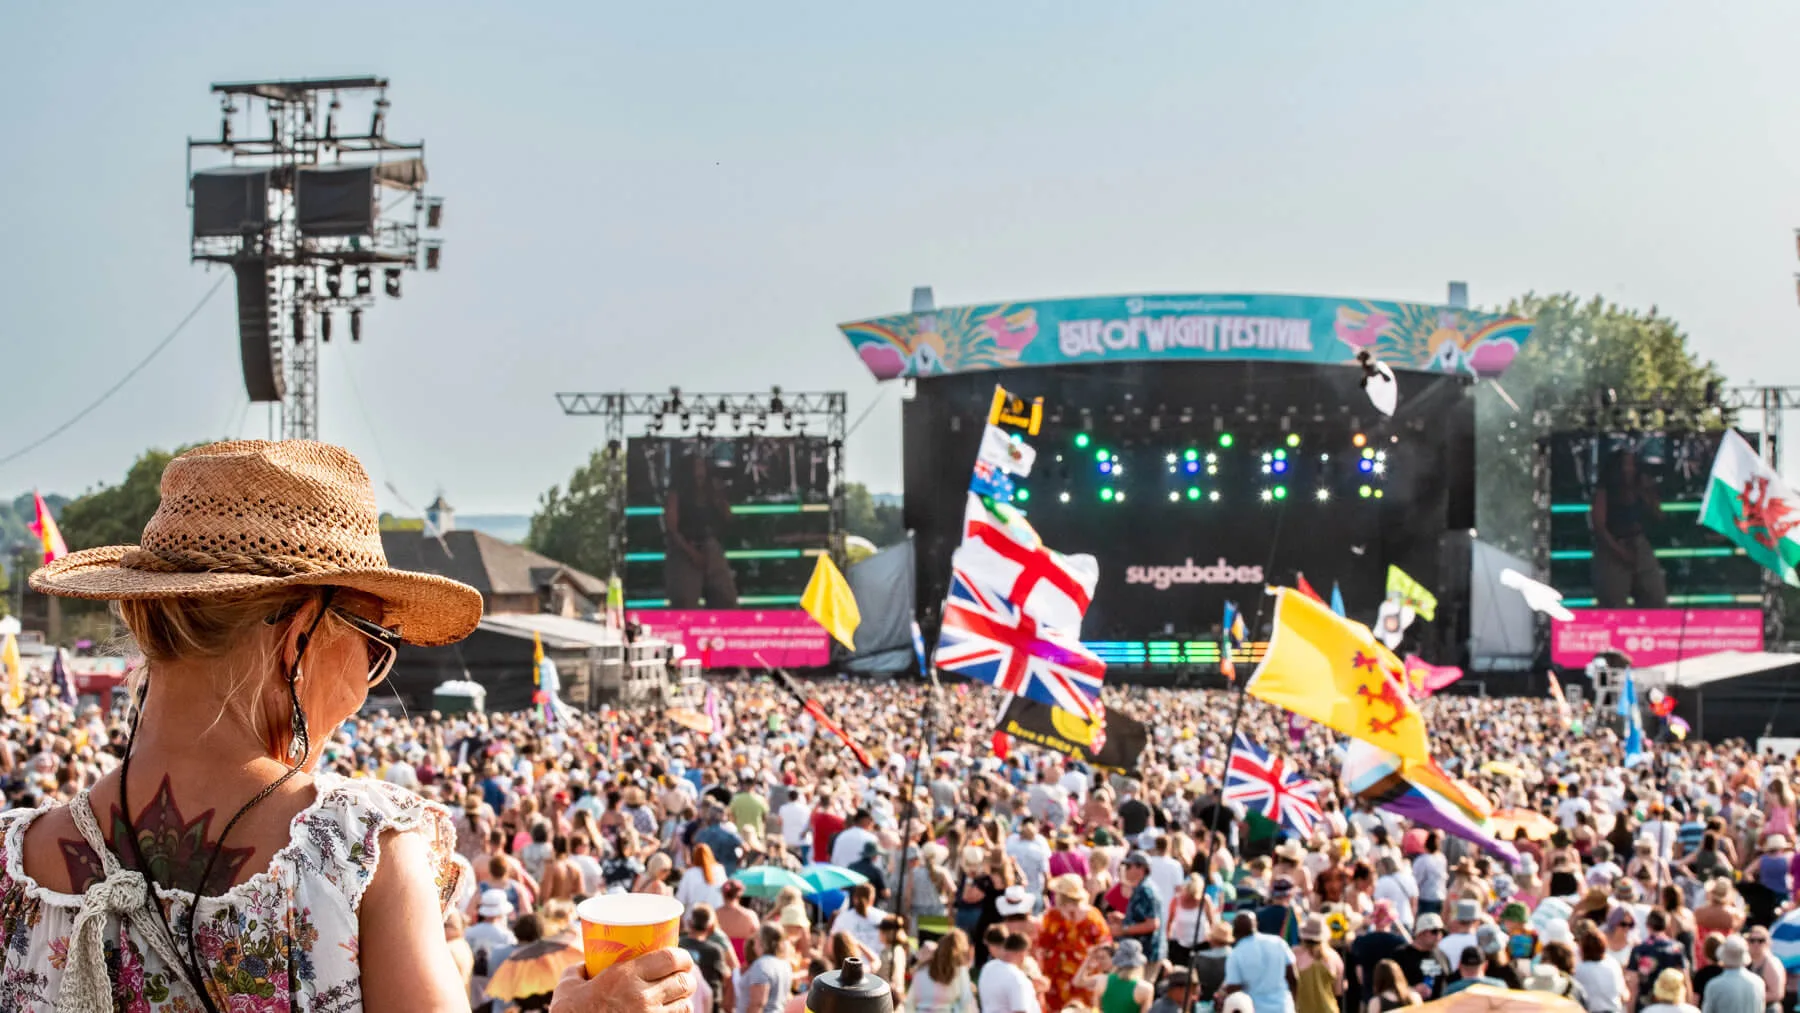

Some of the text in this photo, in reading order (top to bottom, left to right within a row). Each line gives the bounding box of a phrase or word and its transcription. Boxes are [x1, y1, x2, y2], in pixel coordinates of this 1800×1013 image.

[1103, 317, 1146, 348] OF
[1147, 315, 1218, 351] WIGHT
[1219, 317, 1313, 351] FESTIVAL
[1126, 557, 1264, 590] sugababes
